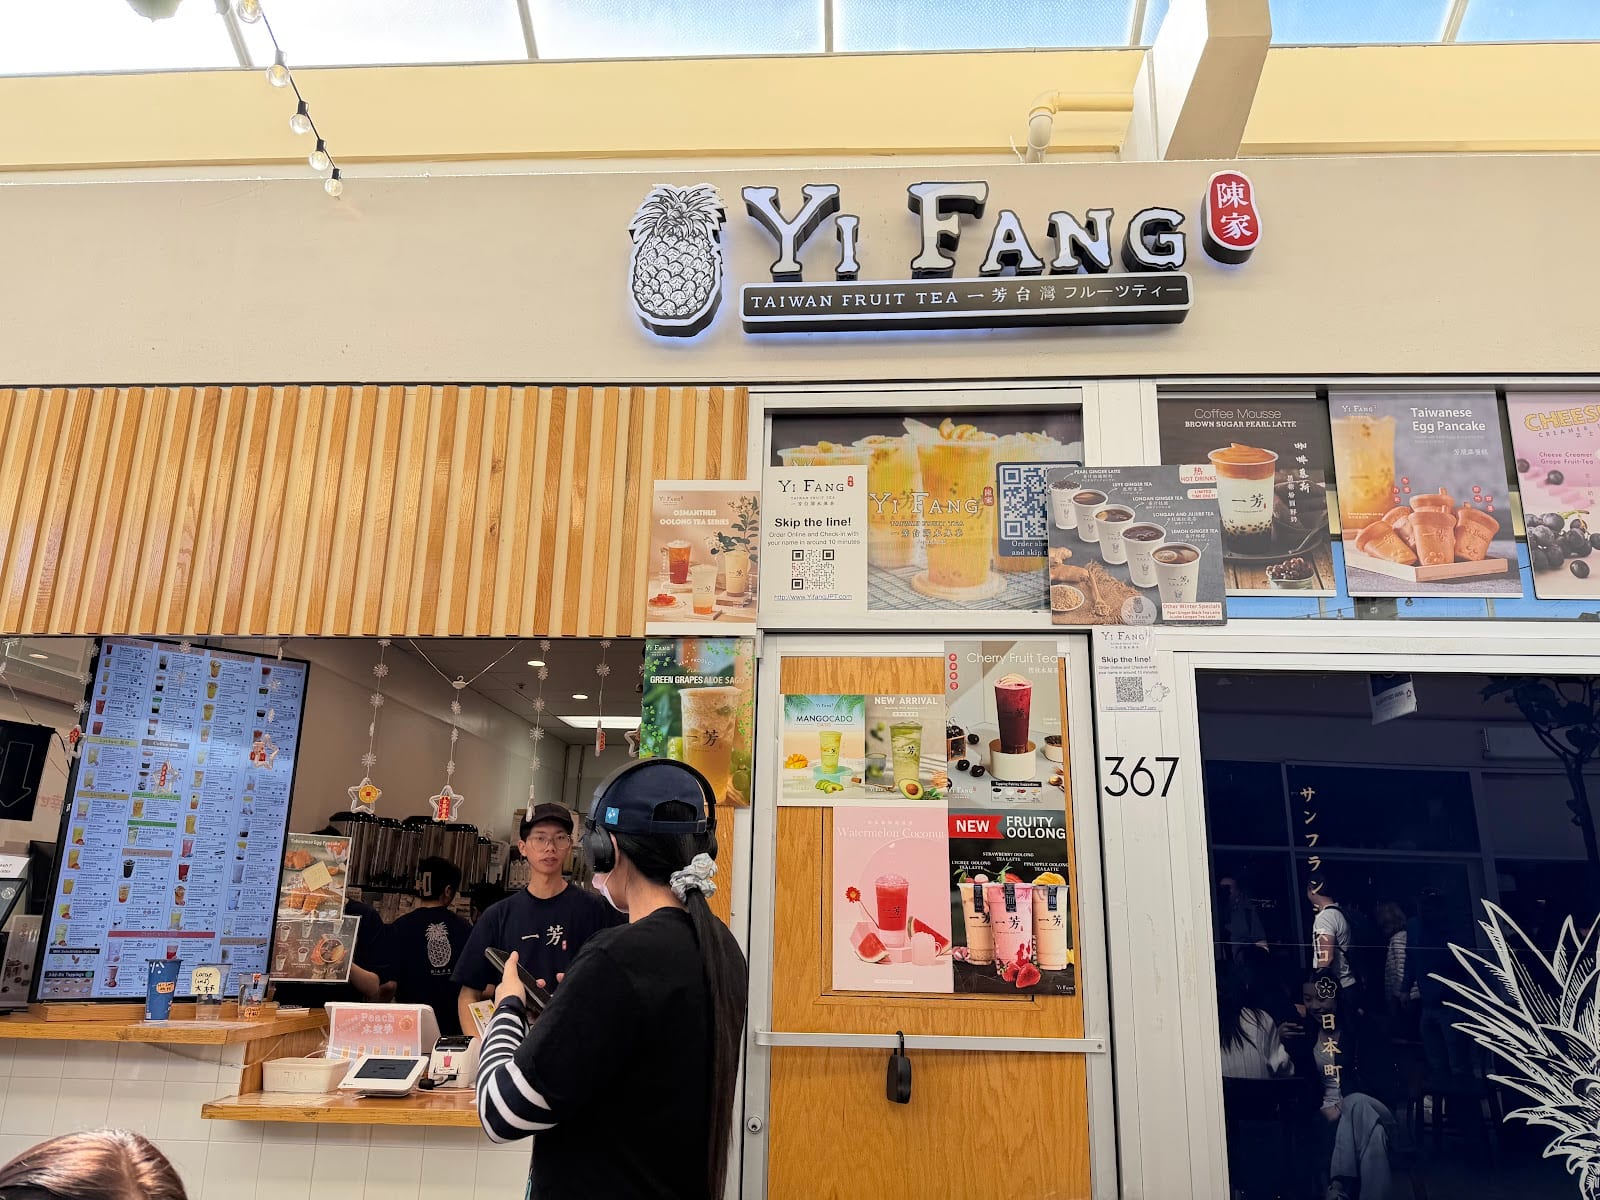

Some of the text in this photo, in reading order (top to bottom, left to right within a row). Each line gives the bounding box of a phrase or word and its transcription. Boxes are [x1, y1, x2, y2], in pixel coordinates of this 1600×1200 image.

[1215, 180, 1254, 240] 陳家
[751, 295, 833, 308] TAIWAN
[842, 293, 906, 307] FRUIT
[916, 291, 959, 305] TEA
[1063, 284, 1184, 298] フルーツティー
[1194, 408, 1282, 419] Coffee Mousse
[1411, 407, 1473, 418] Taiwanese
[1524, 405, 1600, 431] CHEES
[1412, 421, 1486, 433] Egg Pancake
[1232, 493, 1264, 508] 一芳
[774, 517, 851, 529] Skip the line!
[1027, 549, 1042, 557] skip
[966, 652, 1058, 665] Cherry Fruit Tea
[1101, 656, 1119, 664] Skip
[650, 676, 674, 684] GREEN
[675, 676, 703, 684] GRAPES
[703, 676, 723, 684] ALOE
[874, 697, 938, 705] NEW ARRIVAL
[796, 715, 853, 723] MANGOCADO
[687, 729, 719, 747] 一芳
[1104, 757, 1180, 797] 367
[956, 816, 1053, 833] NEW FRUITY
[836, 827, 944, 838] Watermelon Coconut
[1006, 828, 1066, 839] OOLONG
[995, 915, 1021, 930] 一芳
[1038, 914, 1062, 927] 一芳
[521, 925, 565, 947] 一芳
[360, 1013, 395, 1023] Peach
[1321, 1013, 1343, 1088] 日本町
